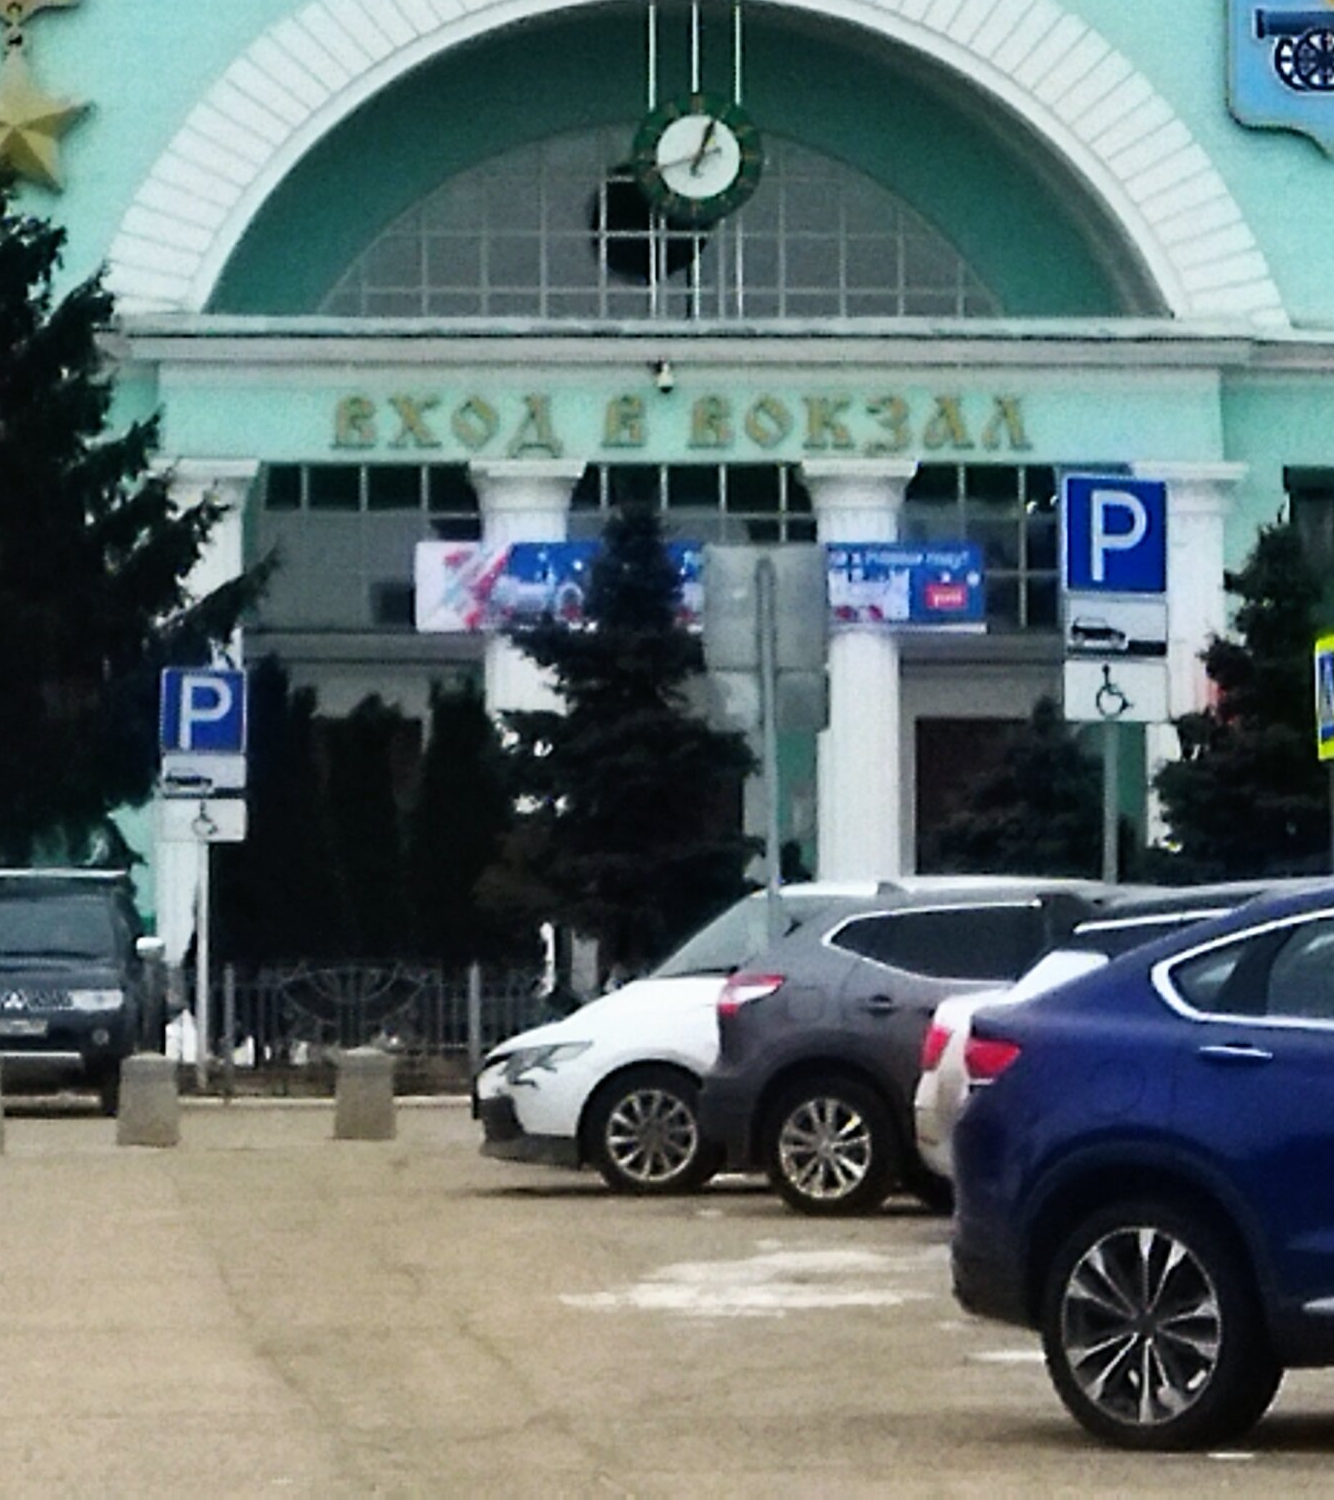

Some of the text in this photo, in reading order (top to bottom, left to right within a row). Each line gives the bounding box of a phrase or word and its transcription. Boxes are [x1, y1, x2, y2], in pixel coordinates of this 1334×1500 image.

[330, 392, 1034, 459] ВХОД В ВОКЗАЛ
[1090, 489, 1148, 582] P
[180, 676, 231, 749] P
